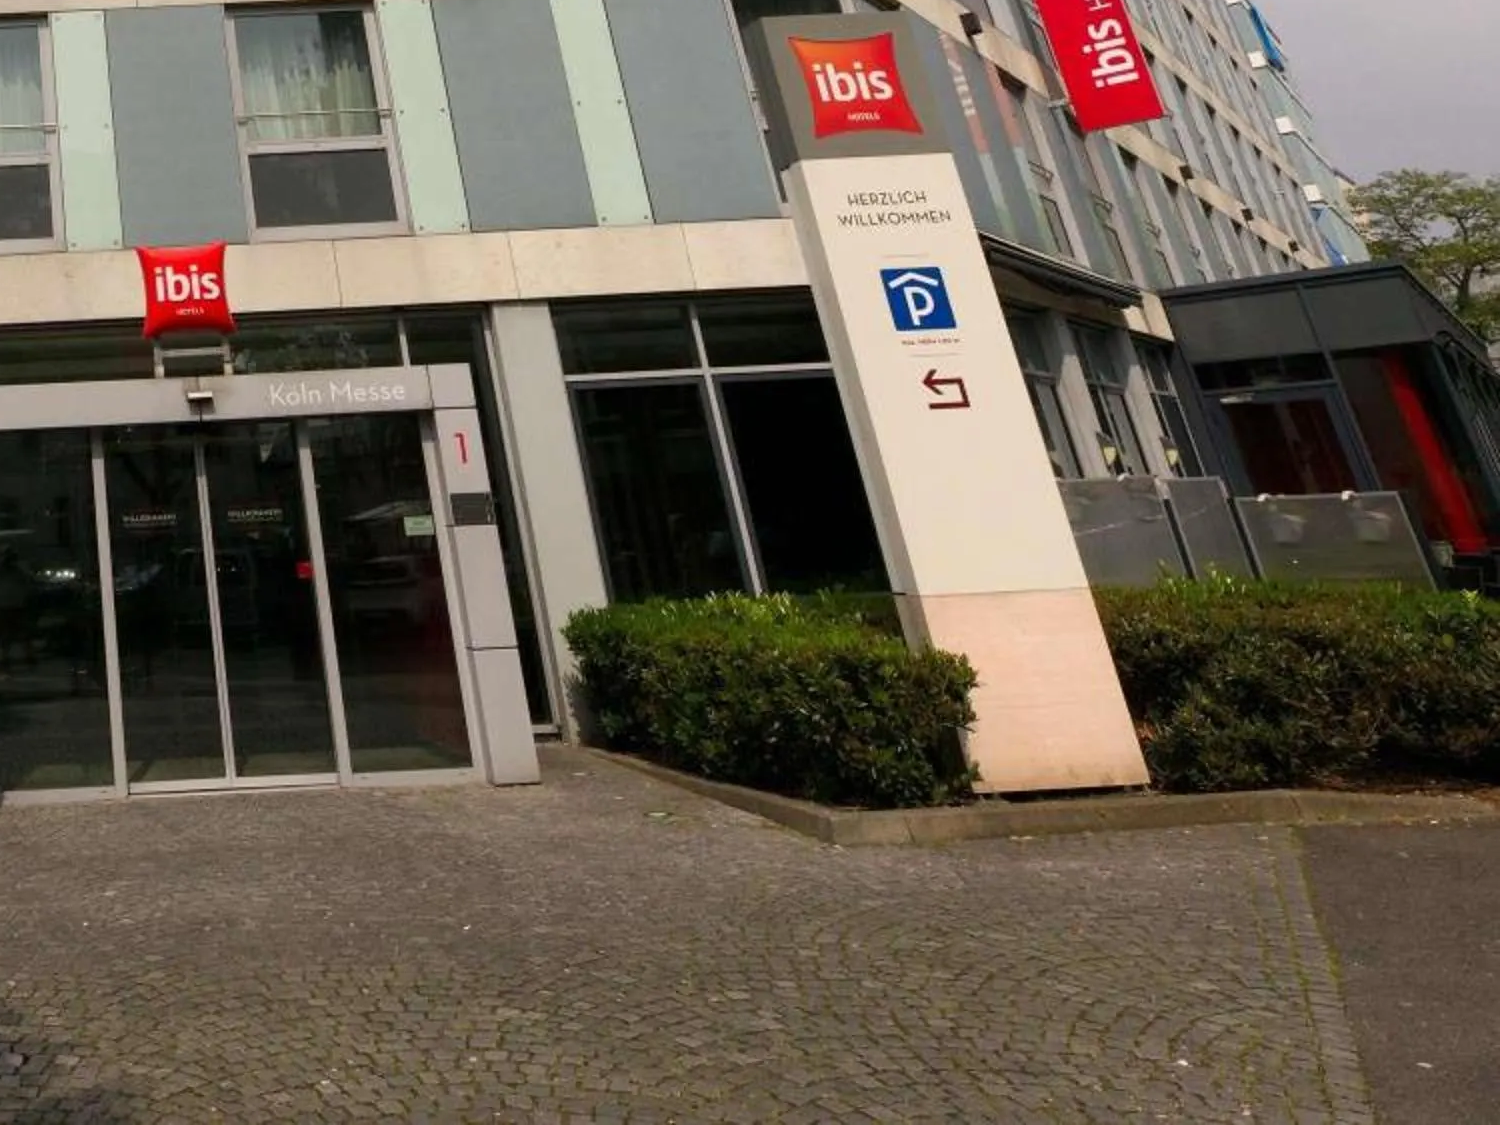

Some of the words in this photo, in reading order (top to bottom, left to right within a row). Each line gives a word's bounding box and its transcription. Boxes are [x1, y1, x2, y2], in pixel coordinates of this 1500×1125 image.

[1082, 18, 1140, 88] ibis
[811, 61, 894, 103] ibis
[847, 189, 927, 207] HERZLICH
[838, 210, 951, 226] WILLKOMMEN
[154, 264, 221, 303] ibis
[903, 286, 935, 326] P
[329, 379, 406, 403] Messe
[454, 431, 468, 464] 1
